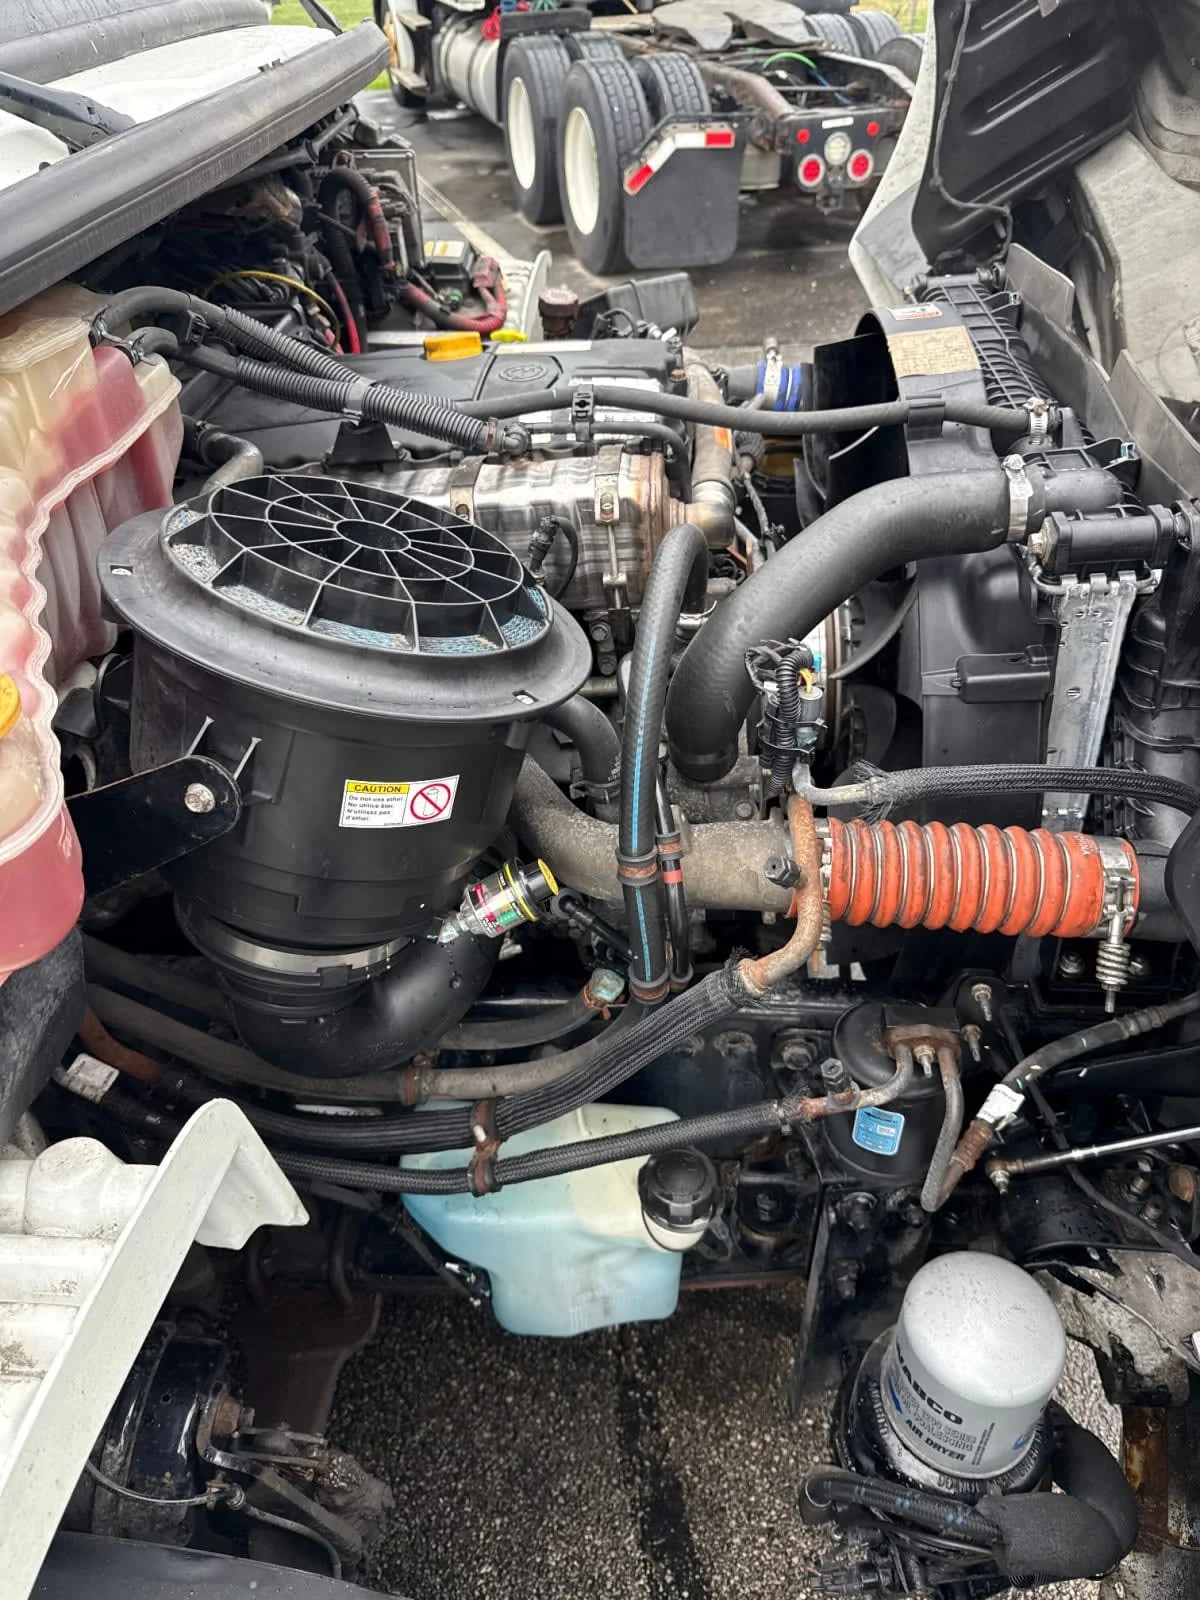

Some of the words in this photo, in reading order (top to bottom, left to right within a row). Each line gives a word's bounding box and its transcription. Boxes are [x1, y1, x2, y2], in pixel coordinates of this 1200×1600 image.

[354, 785, 402, 793] CAUTION
[905, 1419, 923, 1438] AIR
[925, 1437, 966, 1461] DRYER
